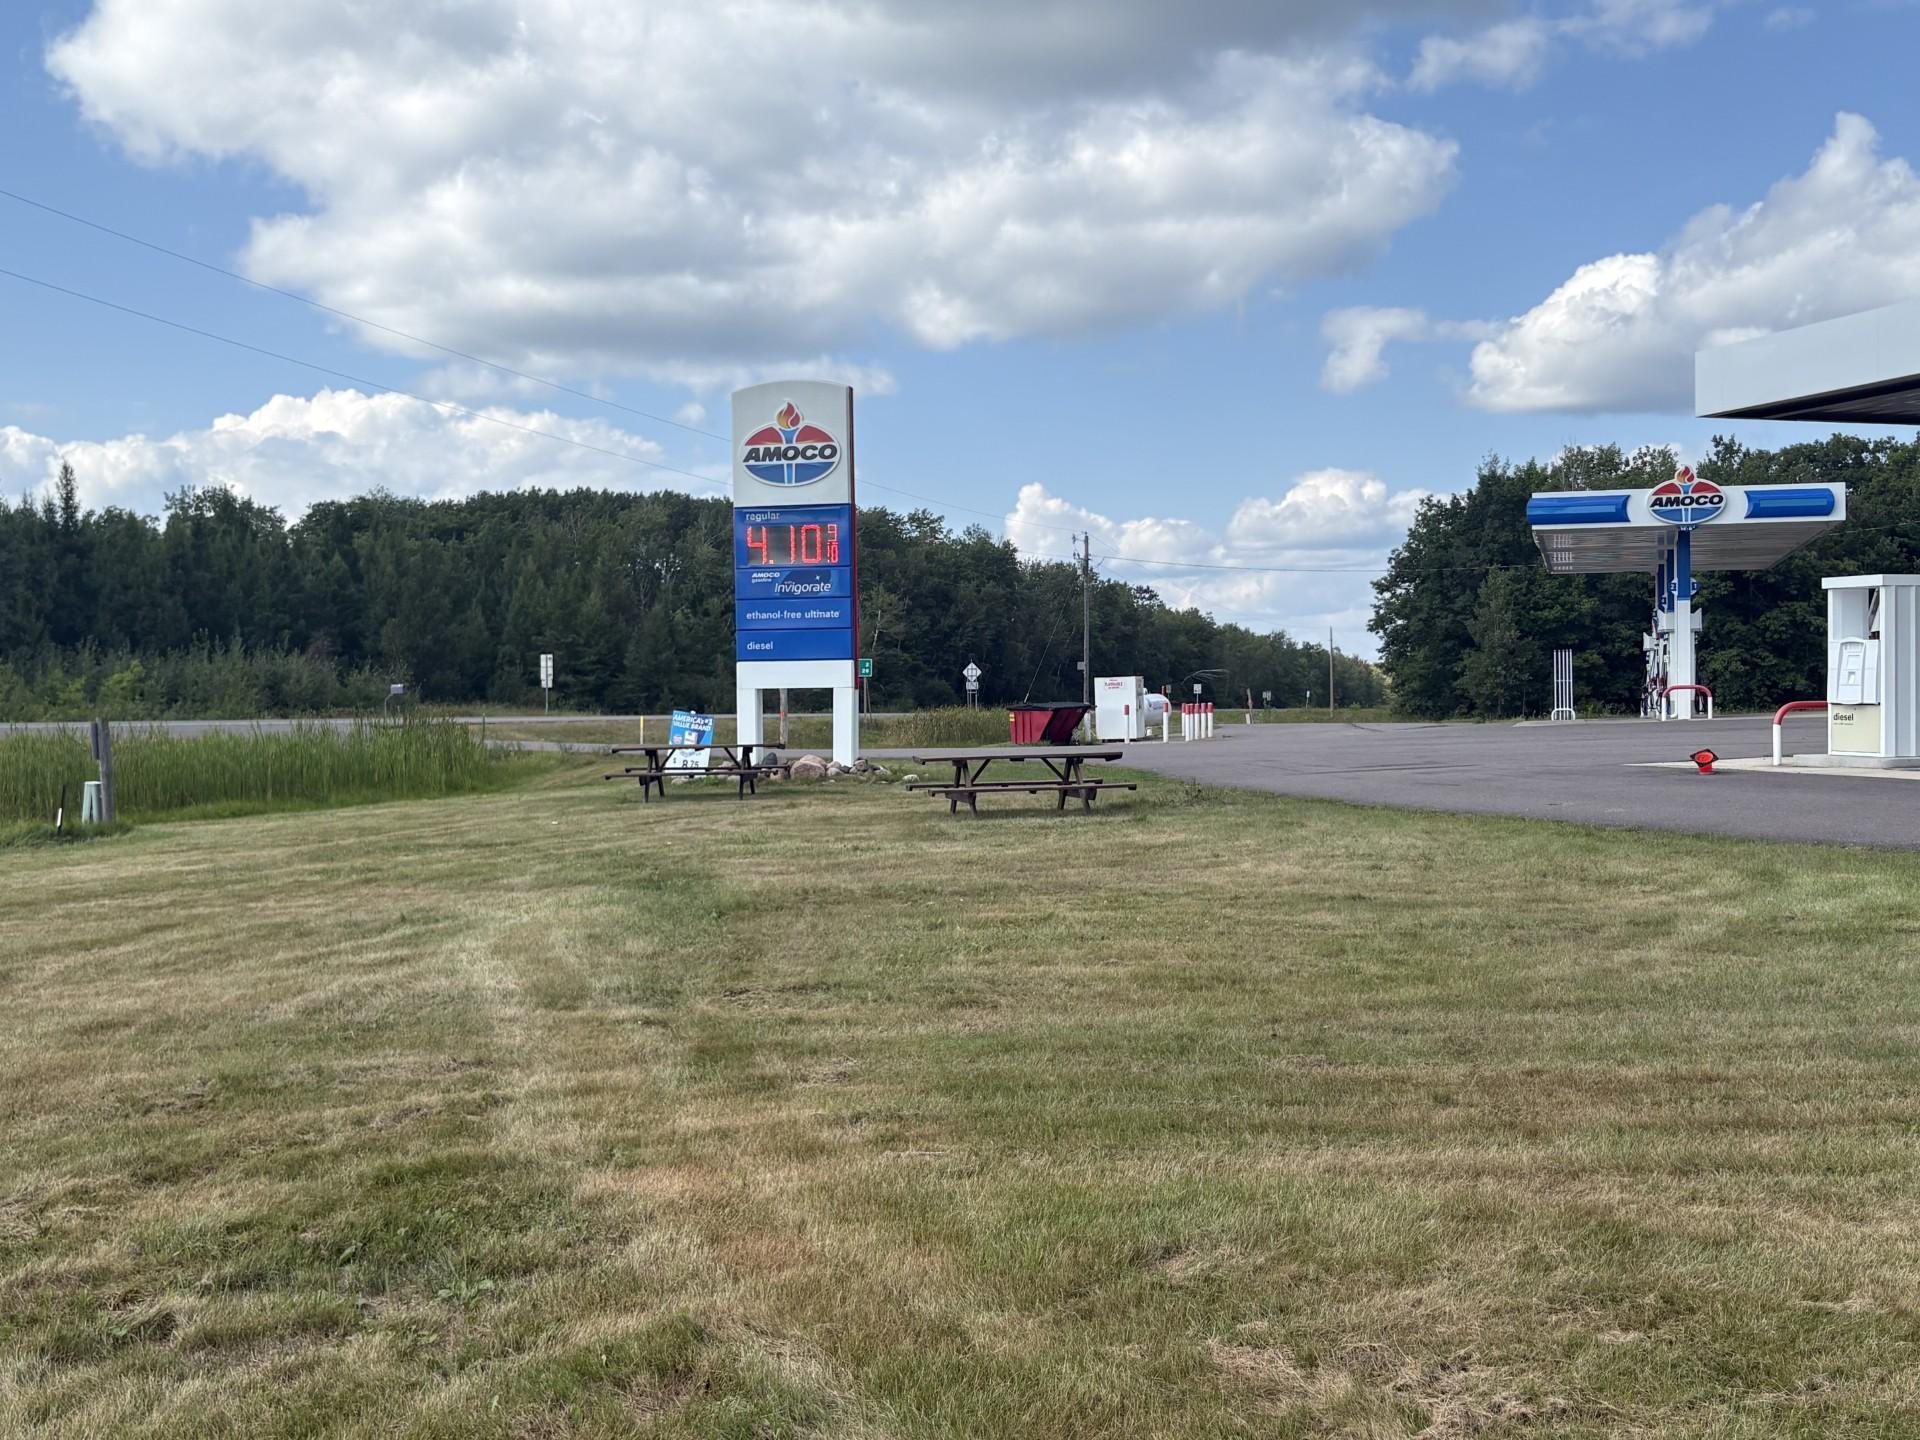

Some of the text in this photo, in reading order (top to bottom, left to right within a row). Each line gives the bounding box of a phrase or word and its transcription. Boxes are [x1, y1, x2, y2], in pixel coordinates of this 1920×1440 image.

[743, 444, 837, 464] AMOCO
[1650, 494, 1724, 508] AMOCO
[746, 511, 780, 521] regular
[774, 581, 832, 595] Invigorate
[746, 609, 840, 620] ethanol-free ultimate
[747, 641, 774, 650] diesel
